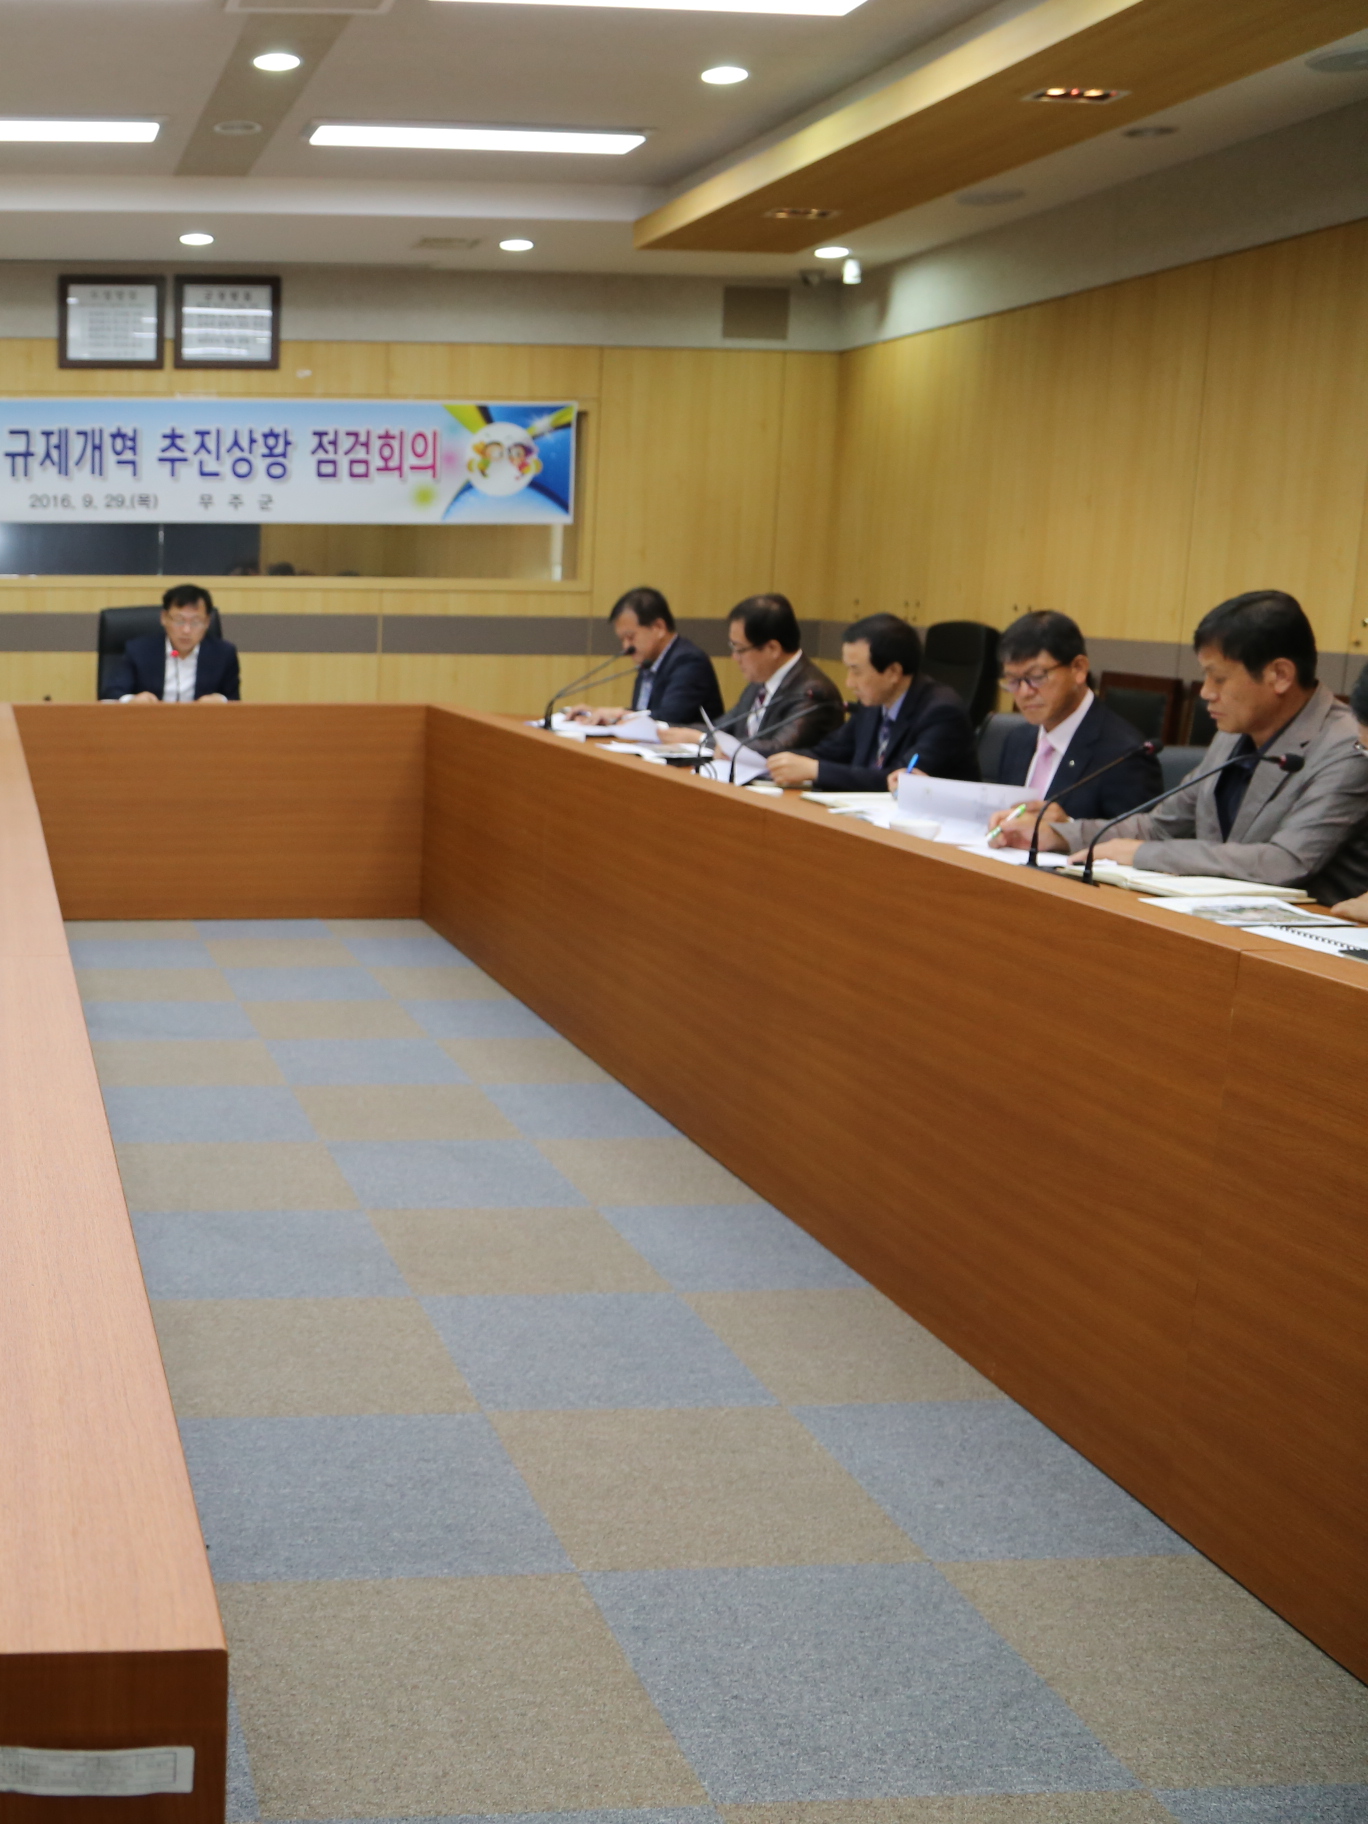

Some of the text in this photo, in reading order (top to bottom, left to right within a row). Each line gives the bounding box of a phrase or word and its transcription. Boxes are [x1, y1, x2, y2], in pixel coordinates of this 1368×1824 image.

[4, 427, 139, 478] 규제개혁
[156, 427, 293, 479] 추진상황
[310, 429, 438, 479] 점검회의
